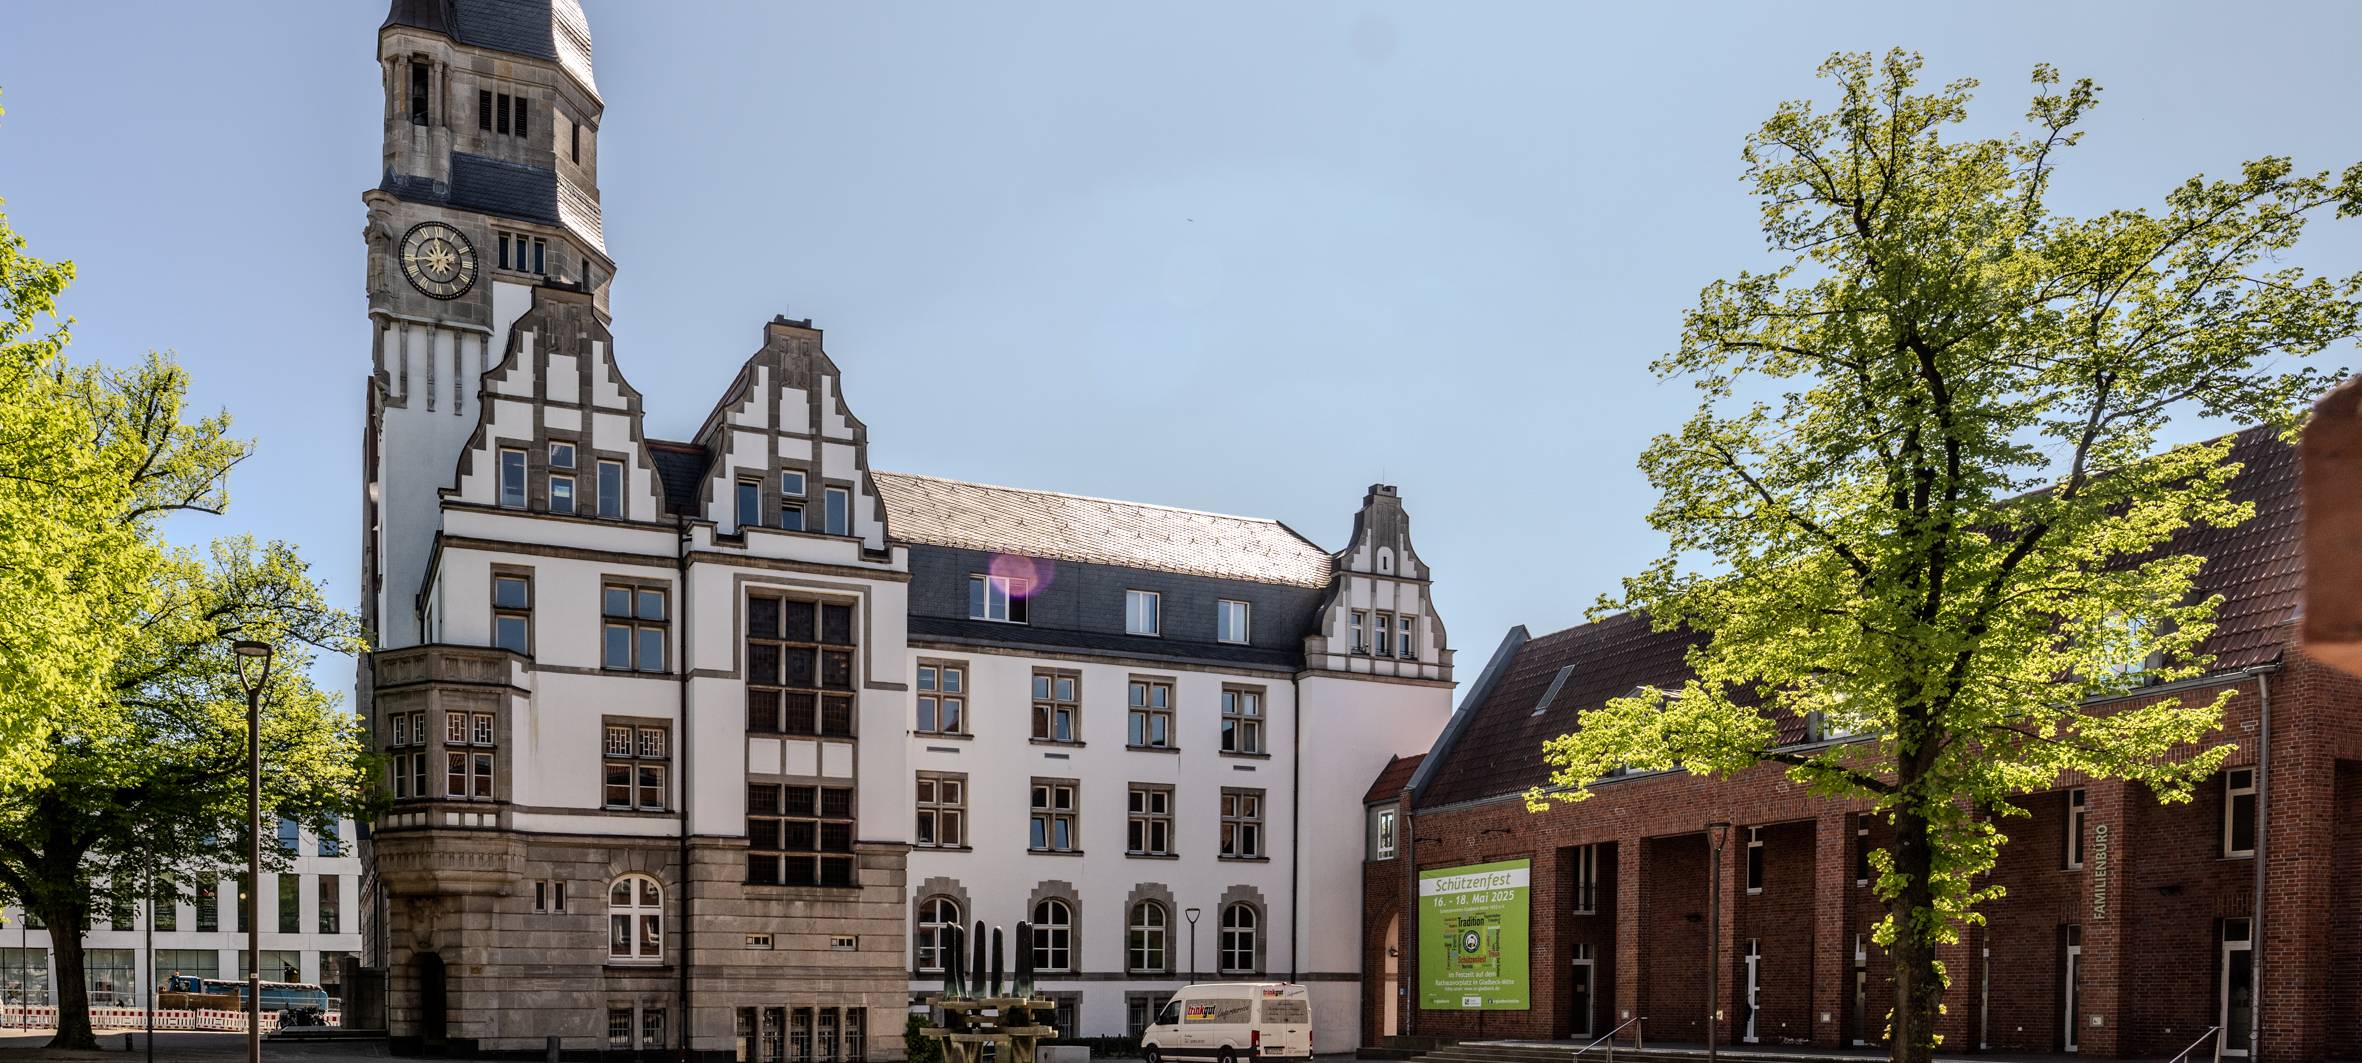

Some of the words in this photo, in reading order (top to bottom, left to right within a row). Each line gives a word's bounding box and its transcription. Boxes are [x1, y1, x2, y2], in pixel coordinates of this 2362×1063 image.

[462, 260, 473, 269] III
[2093, 824, 2108, 920] FAMILIENBÜRO
[1435, 872, 1512, 892] Schützenfest
[1434, 897, 1447, 908] 16.
[1456, 894, 1469, 905] 18.
[1472, 892, 1488, 904] Mai
[1491, 890, 1515, 902] 2025
[1457, 916, 1485, 927] Tradition
[1263, 989, 1284, 997] trinkgut
[1187, 1003, 1216, 1018] trinkgut
